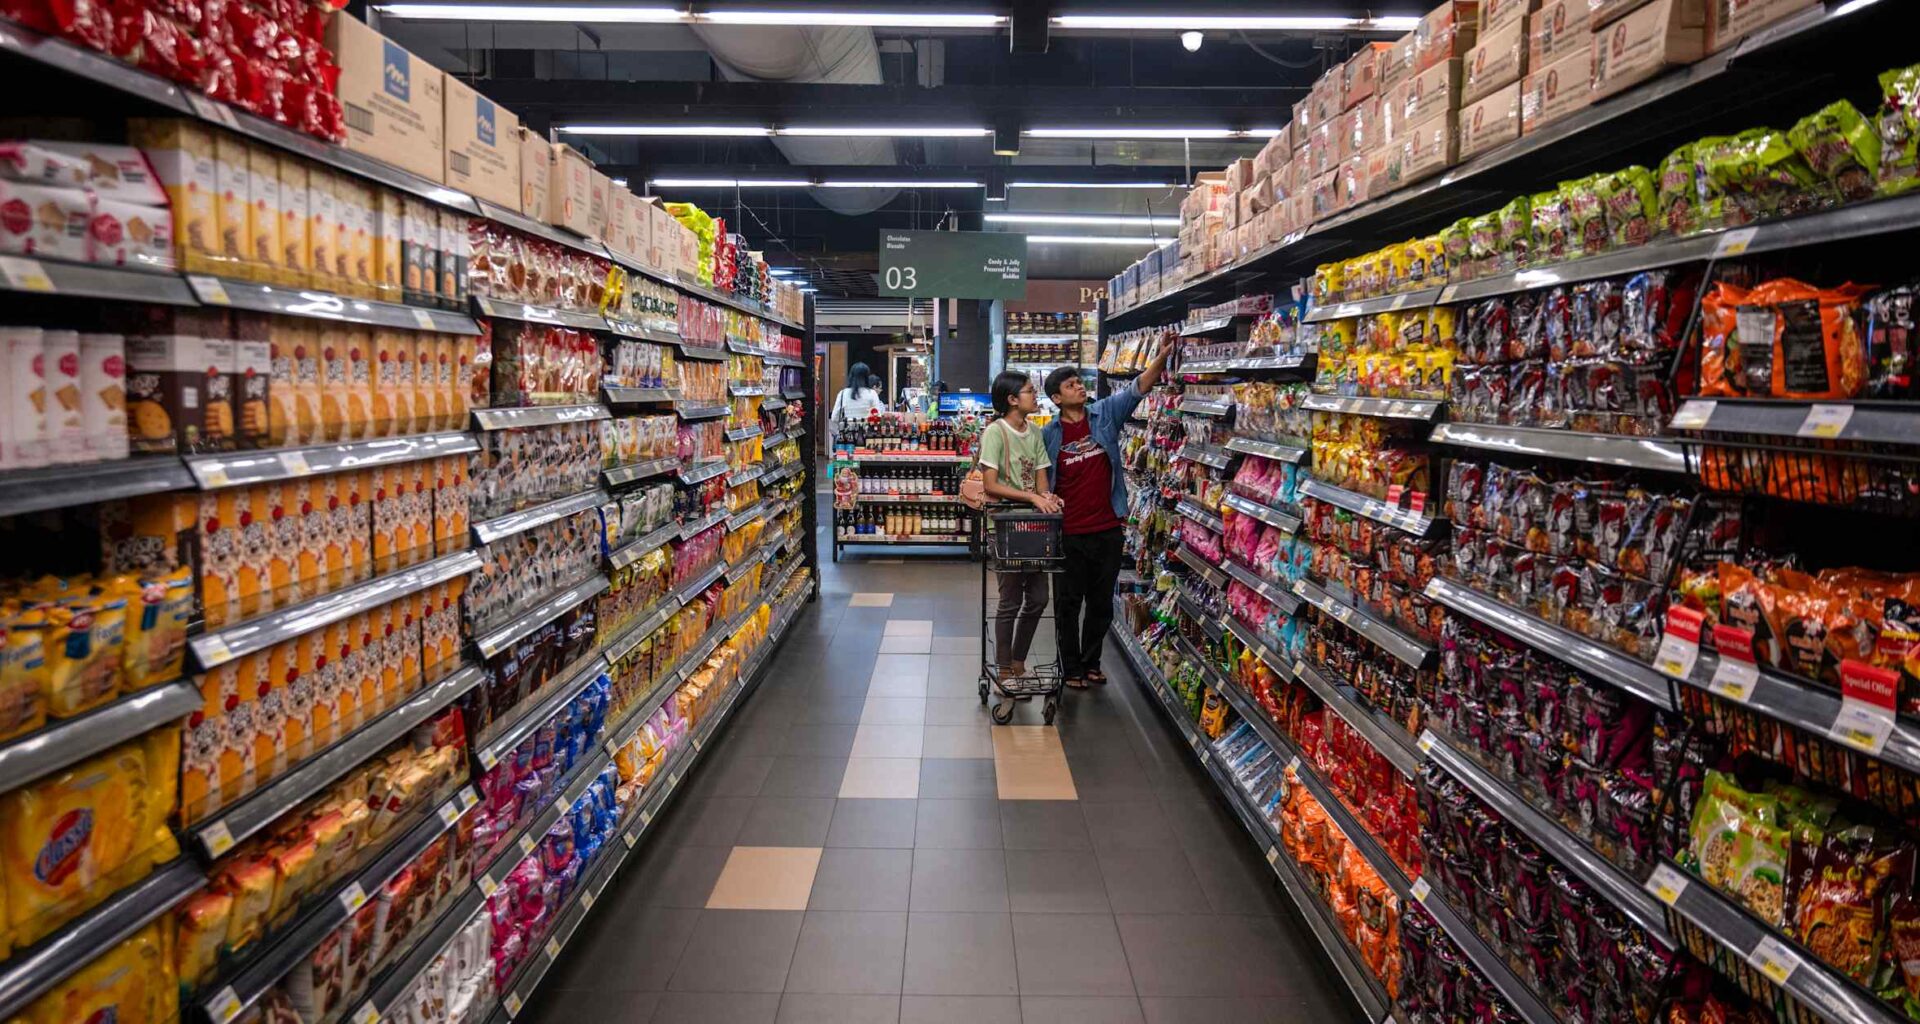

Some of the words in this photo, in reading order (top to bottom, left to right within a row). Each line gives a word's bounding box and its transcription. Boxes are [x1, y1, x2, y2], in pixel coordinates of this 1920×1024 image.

[987, 258, 1002, 266] Candy
[1009, 259, 1020, 267] Jelly
[983, 265, 1005, 273] Preserved
[885, 266, 917, 290] 03
[1668, 616, 1686, 628] Special
[1715, 637, 1733, 649] Special
[1843, 674, 1870, 690] Special
[1871, 680, 1893, 697] Offer
